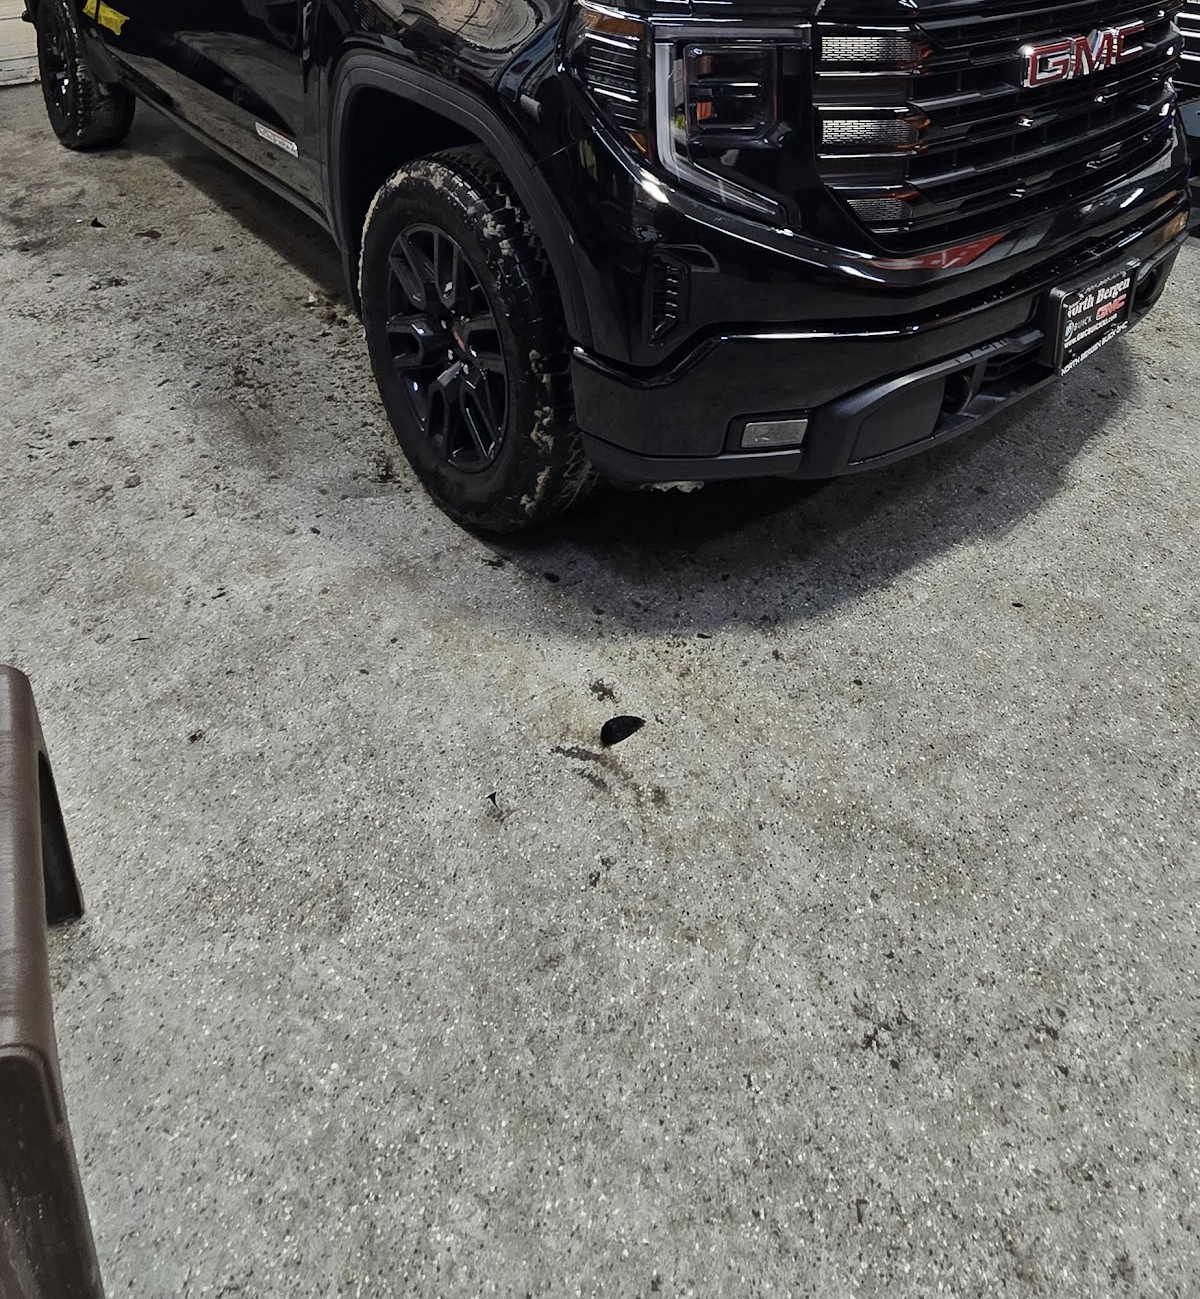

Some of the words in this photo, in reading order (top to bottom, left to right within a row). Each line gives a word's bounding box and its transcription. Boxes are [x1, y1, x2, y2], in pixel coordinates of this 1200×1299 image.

[1021, 20, 1145, 88] GMC
[1096, 277, 1130, 304] Bergen
[1096, 293, 1126, 321] GMC
[1061, 356, 1080, 376] NORTH
[1080, 340, 1102, 362] BERGEN
